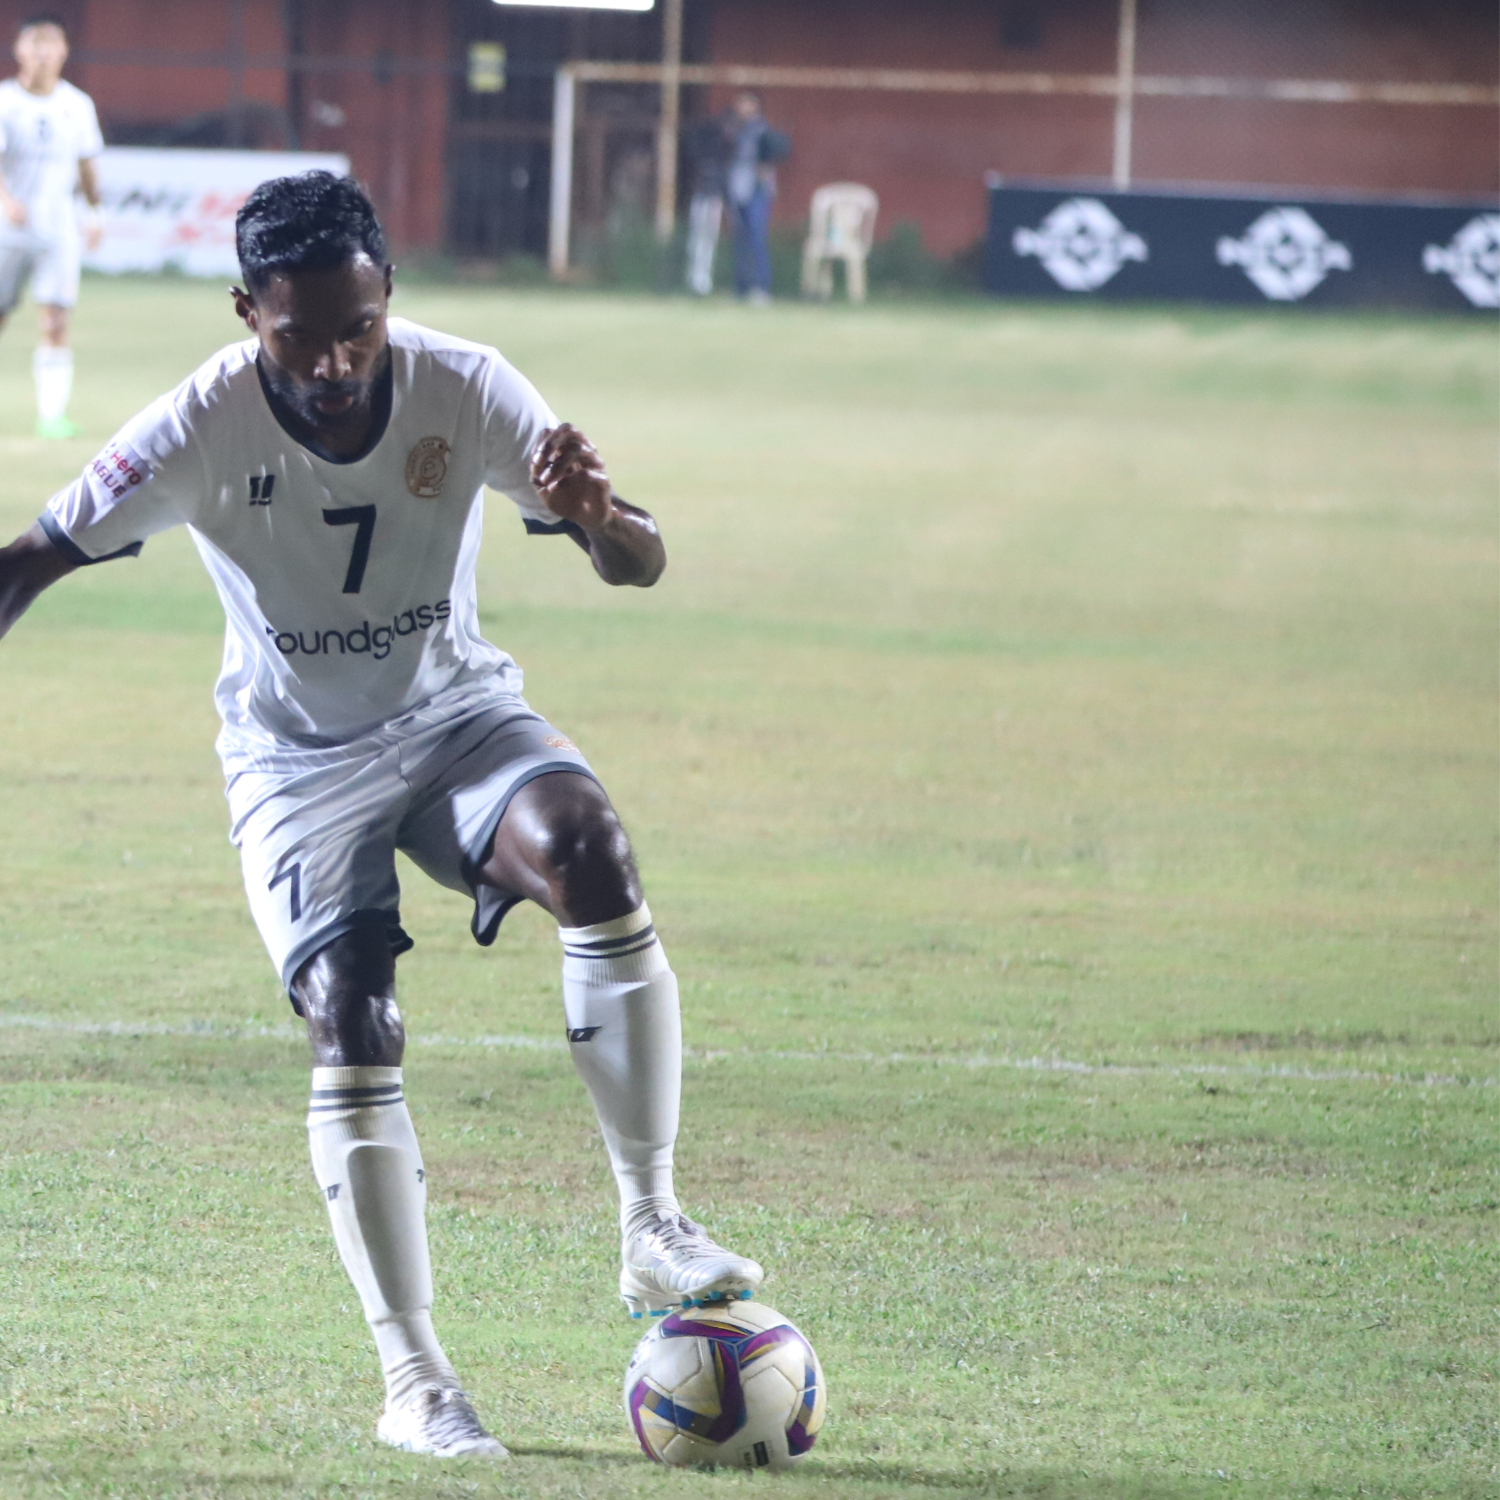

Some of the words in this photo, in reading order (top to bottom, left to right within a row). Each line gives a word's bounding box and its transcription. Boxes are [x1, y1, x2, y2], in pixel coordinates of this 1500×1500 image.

[110, 450, 141, 485] Hero
[322, 504, 377, 594] 7
[268, 862, 301, 923] 7
